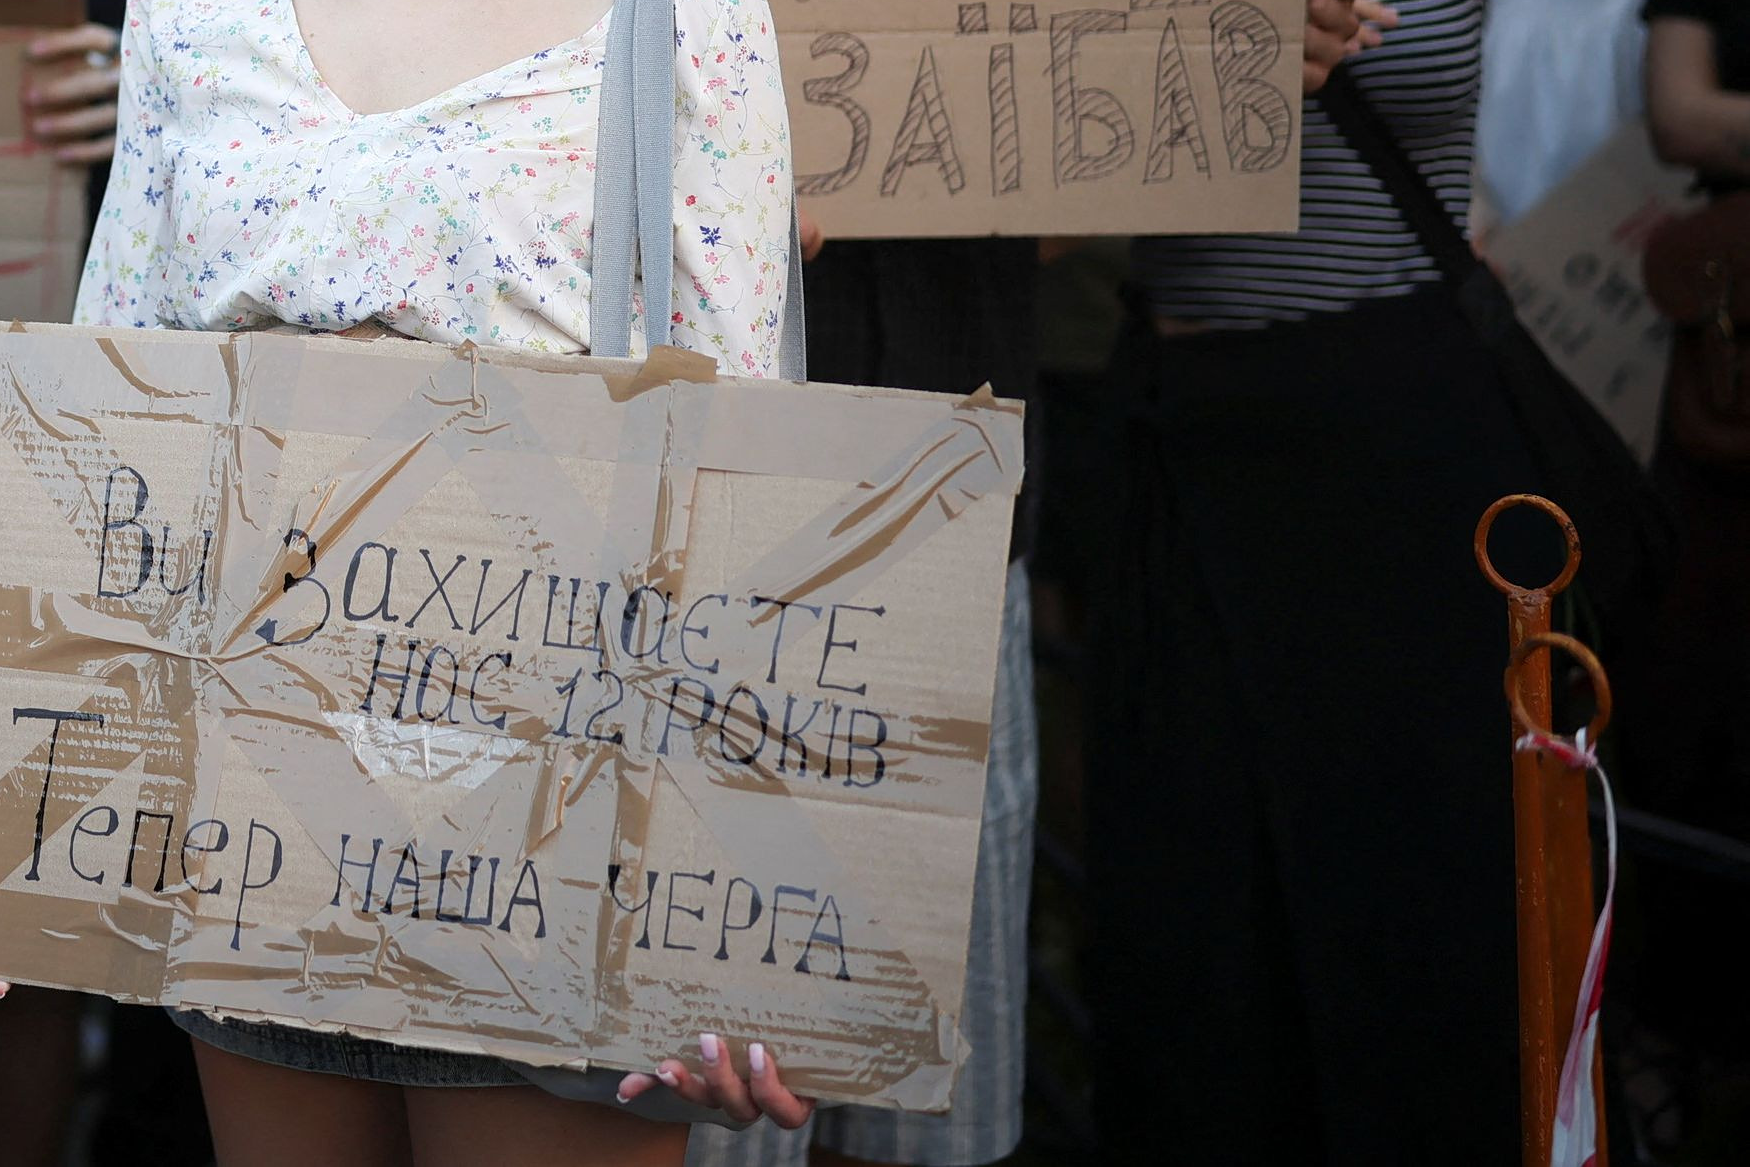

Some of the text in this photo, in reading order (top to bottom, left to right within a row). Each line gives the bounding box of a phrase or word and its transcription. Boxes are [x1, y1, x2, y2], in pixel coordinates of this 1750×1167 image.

[794, 0, 1293, 200] ЗАЇБАВ
[96, 466, 214, 606] Ви
[552, 667, 624, 745] 12
[656, 676, 888, 788] РОКІВ
[13, 707, 852, 981] Тепер НАША ЧЕРГА
